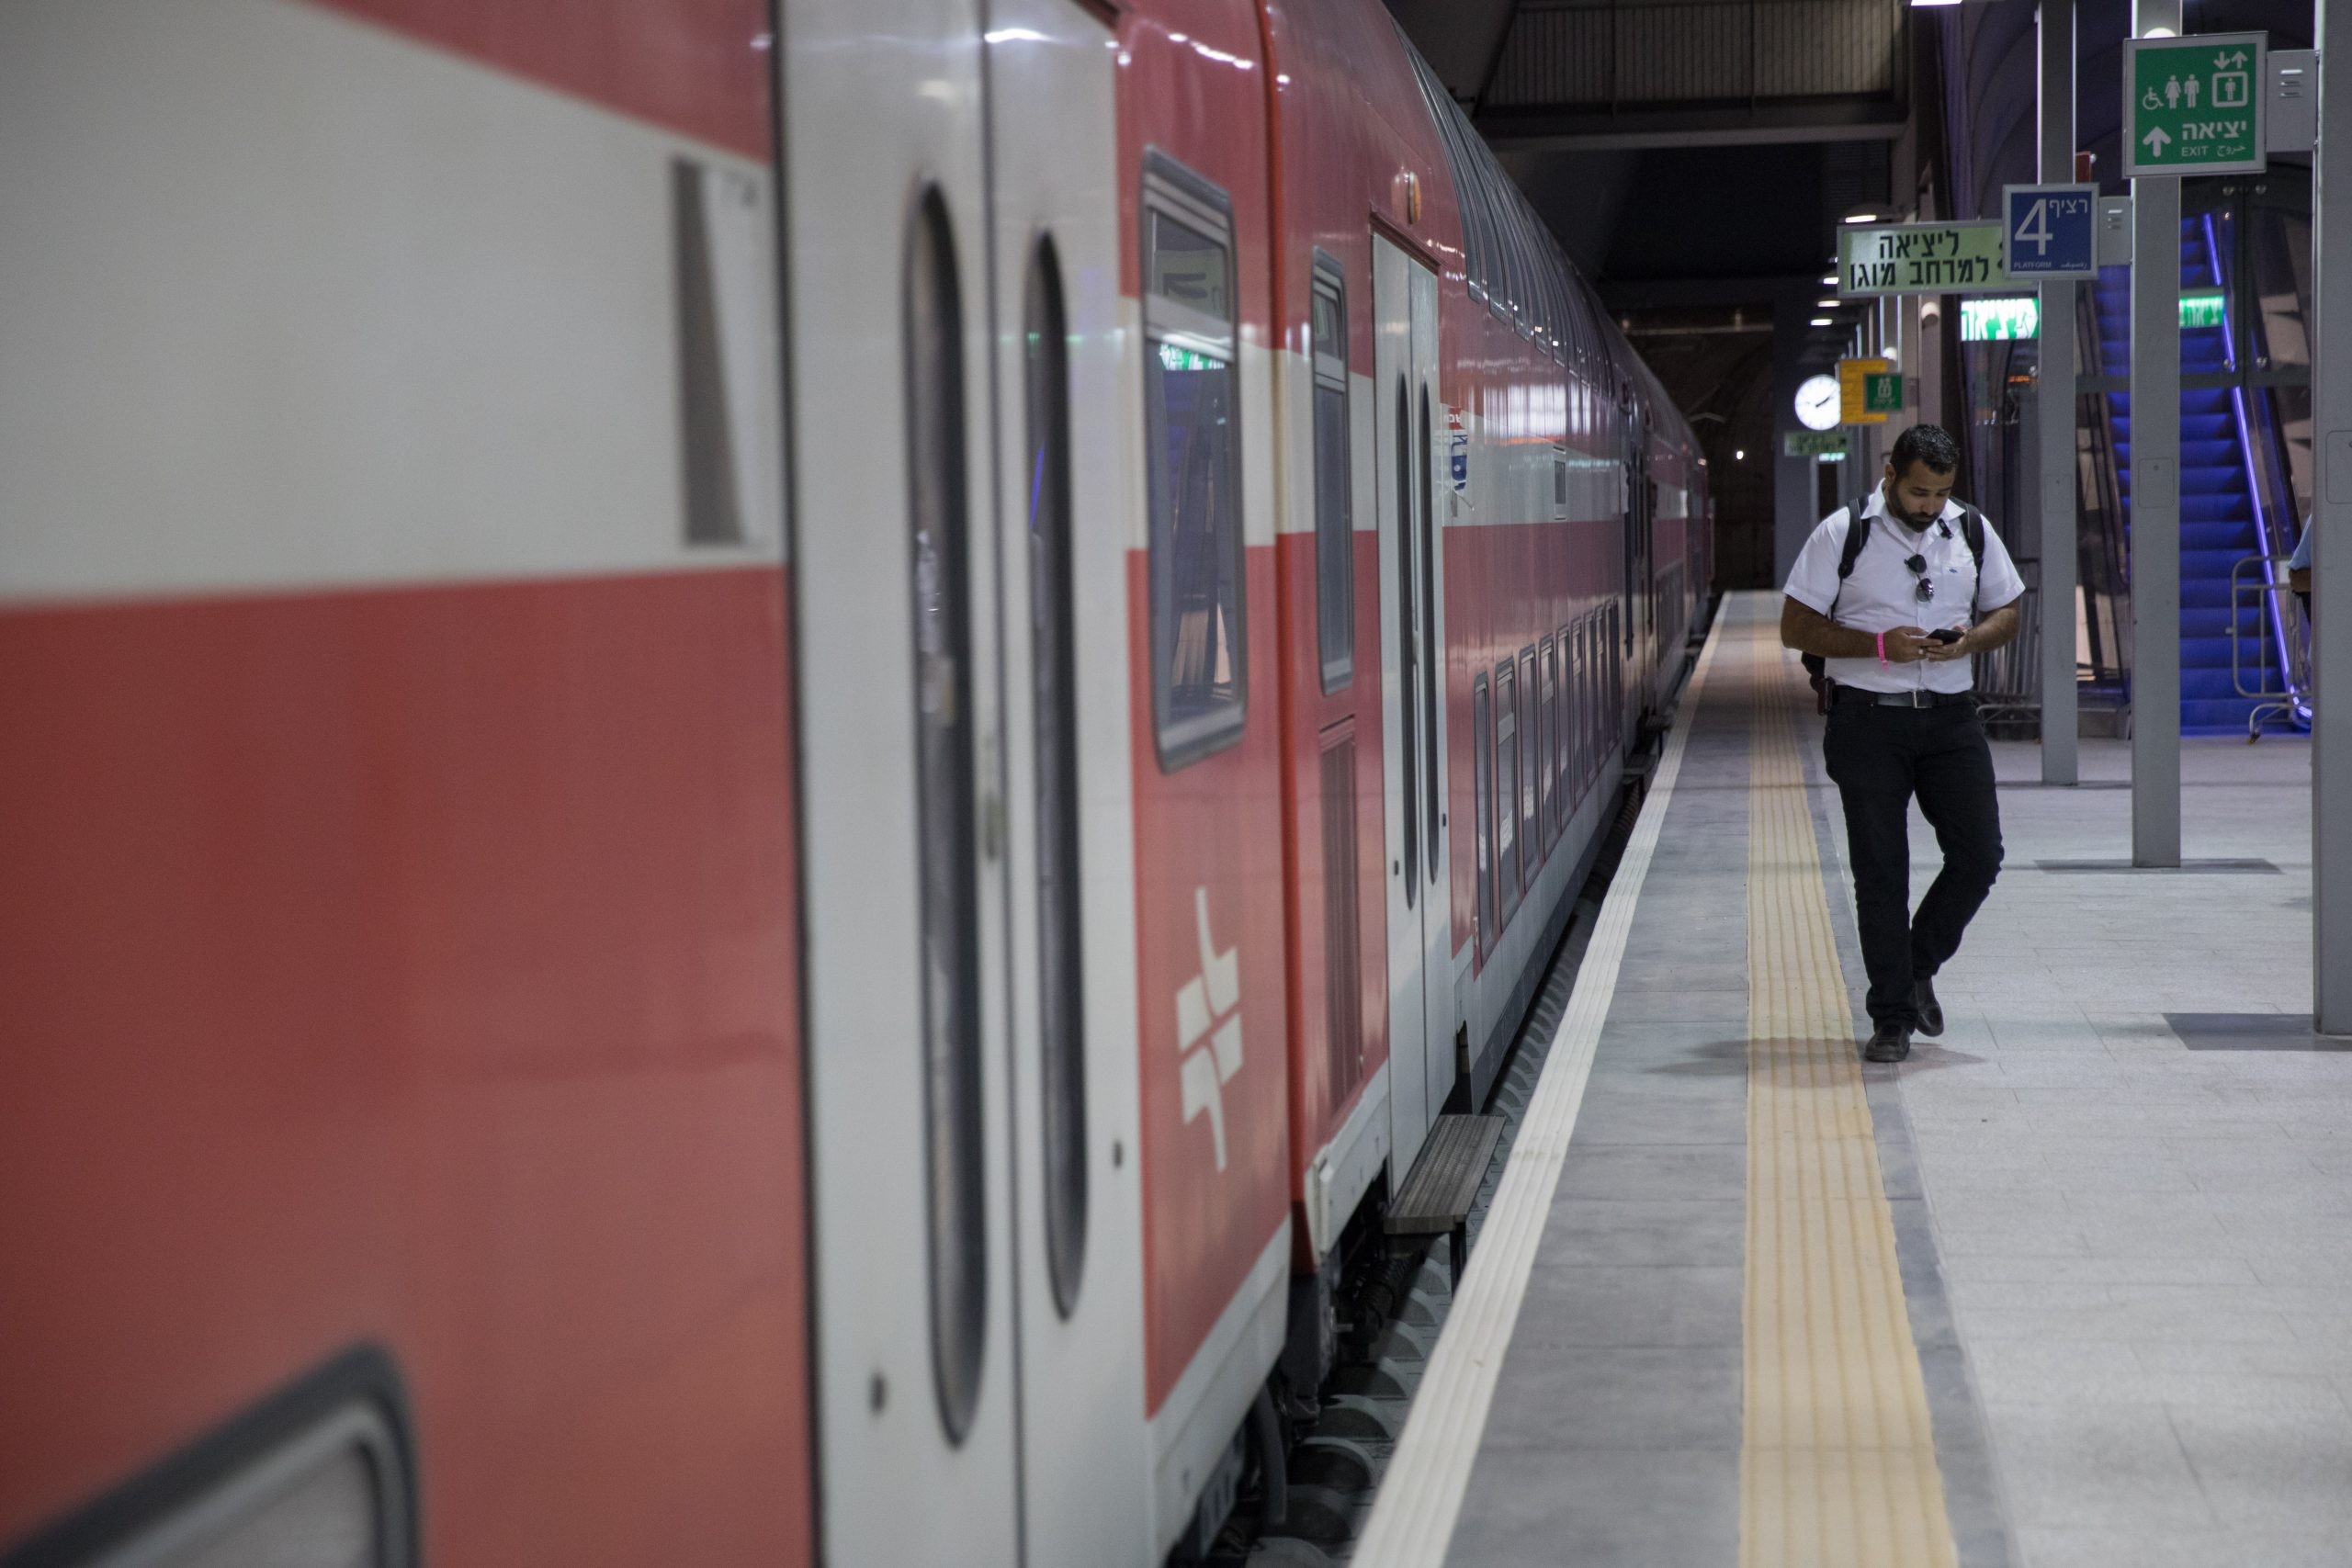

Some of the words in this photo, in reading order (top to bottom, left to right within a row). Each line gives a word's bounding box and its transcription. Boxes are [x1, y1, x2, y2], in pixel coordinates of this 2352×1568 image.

[2182, 120, 2246, 141] יציאה
[2181, 145, 2209, 157] EXIT
[2217, 145, 2246, 157] خروج
[2049, 198, 2087, 219] רציף
[2014, 198, 2053, 255] 4
[1880, 230, 1959, 259] ליציאה
[1850, 262, 1896, 290] מוגן
[1909, 255, 1989, 285] למרחב
